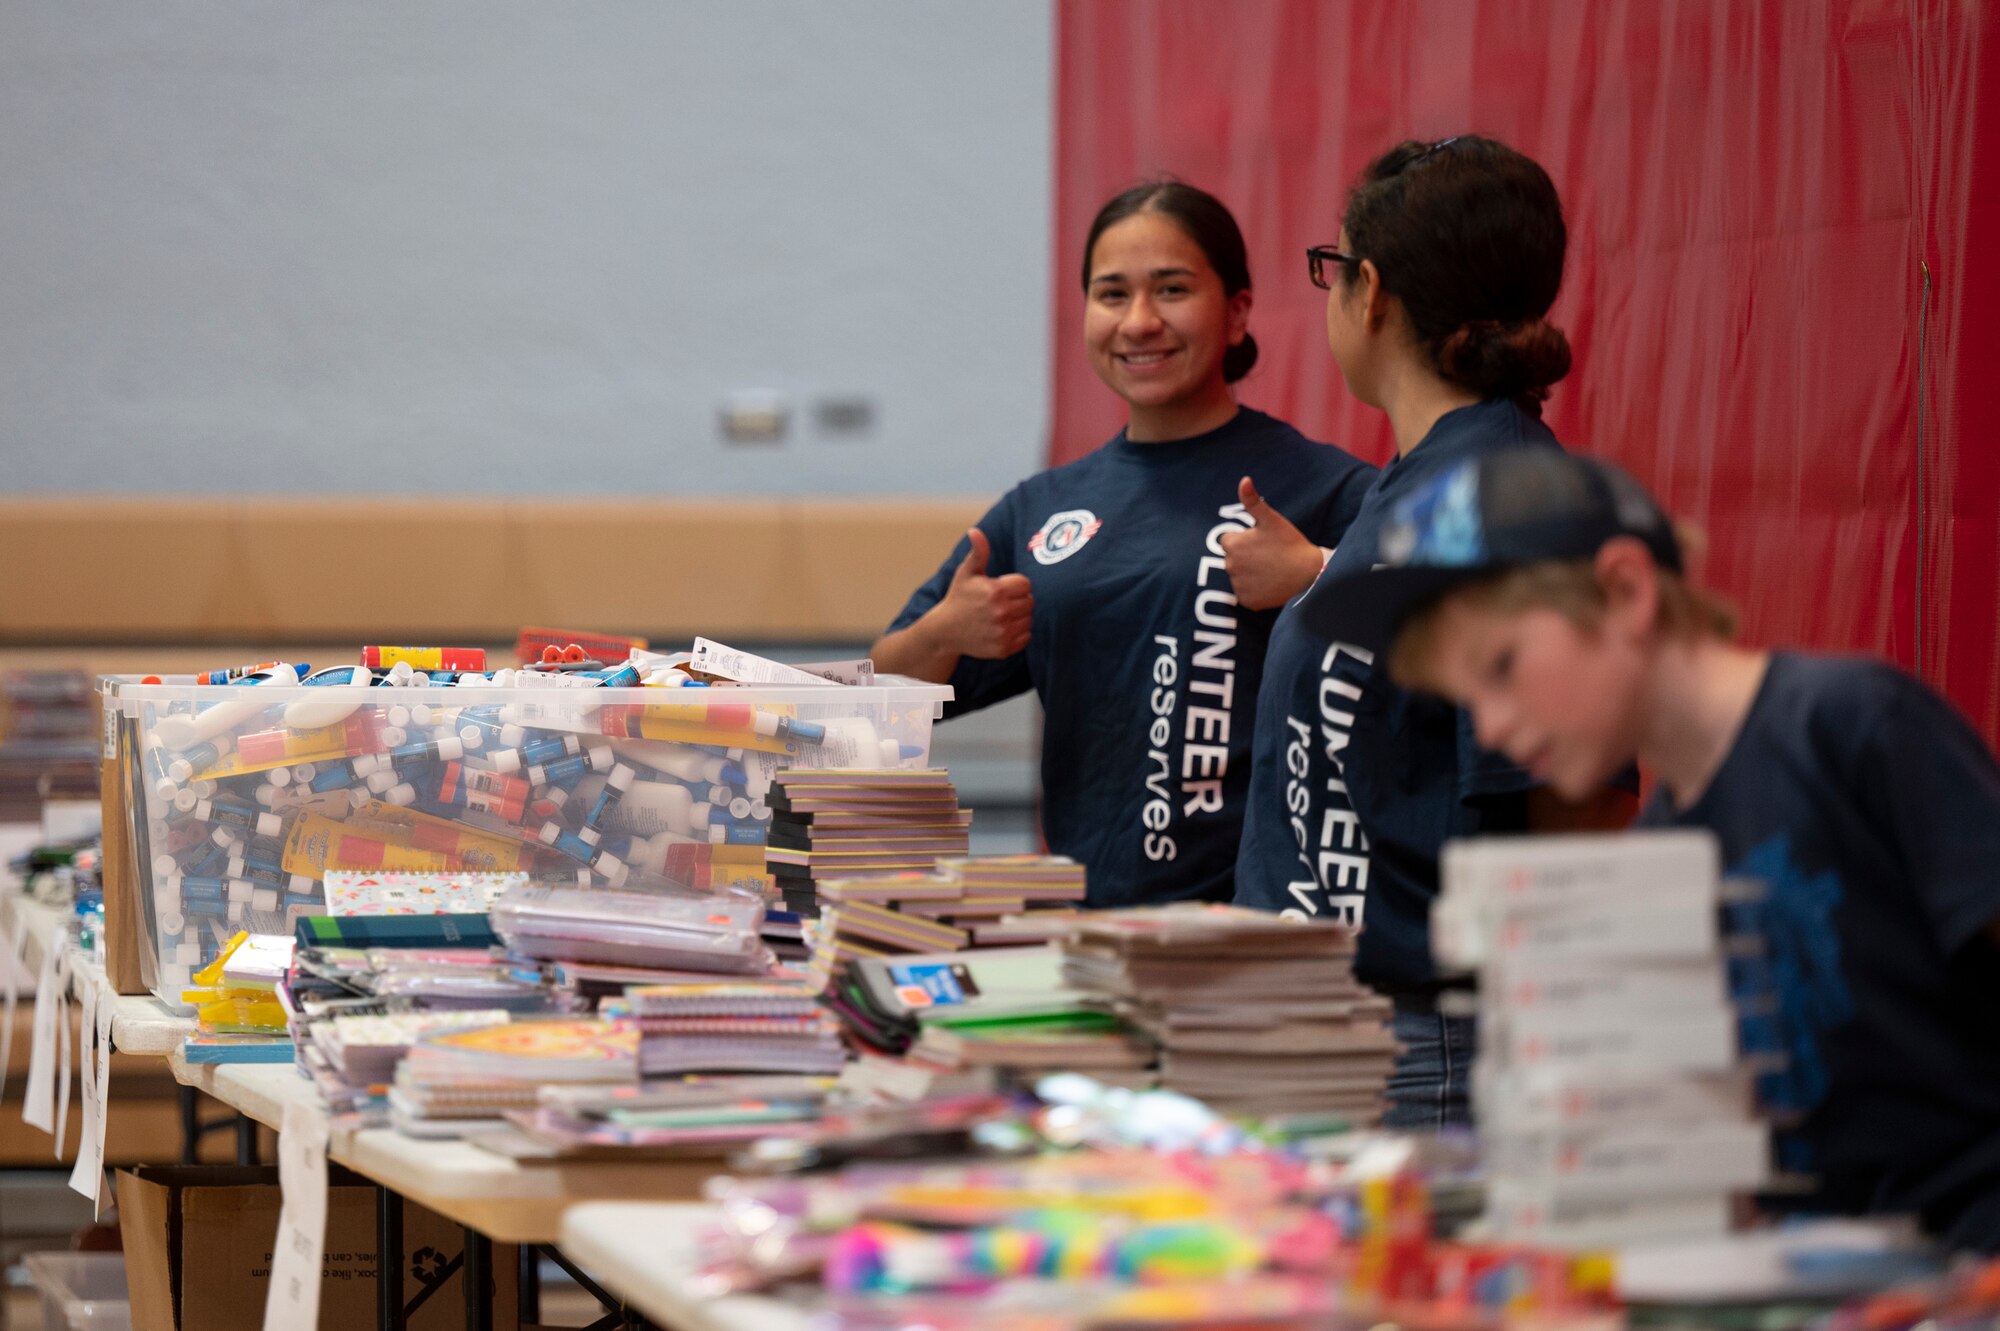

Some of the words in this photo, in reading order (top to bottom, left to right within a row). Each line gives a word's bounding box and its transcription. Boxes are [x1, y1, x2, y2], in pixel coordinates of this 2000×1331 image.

[1181, 503, 1256, 818] VOLUNTEER
[1142, 634, 1178, 861] reserves
[331, 1268, 351, 1281] like
[332, 1253, 352, 1263] can
